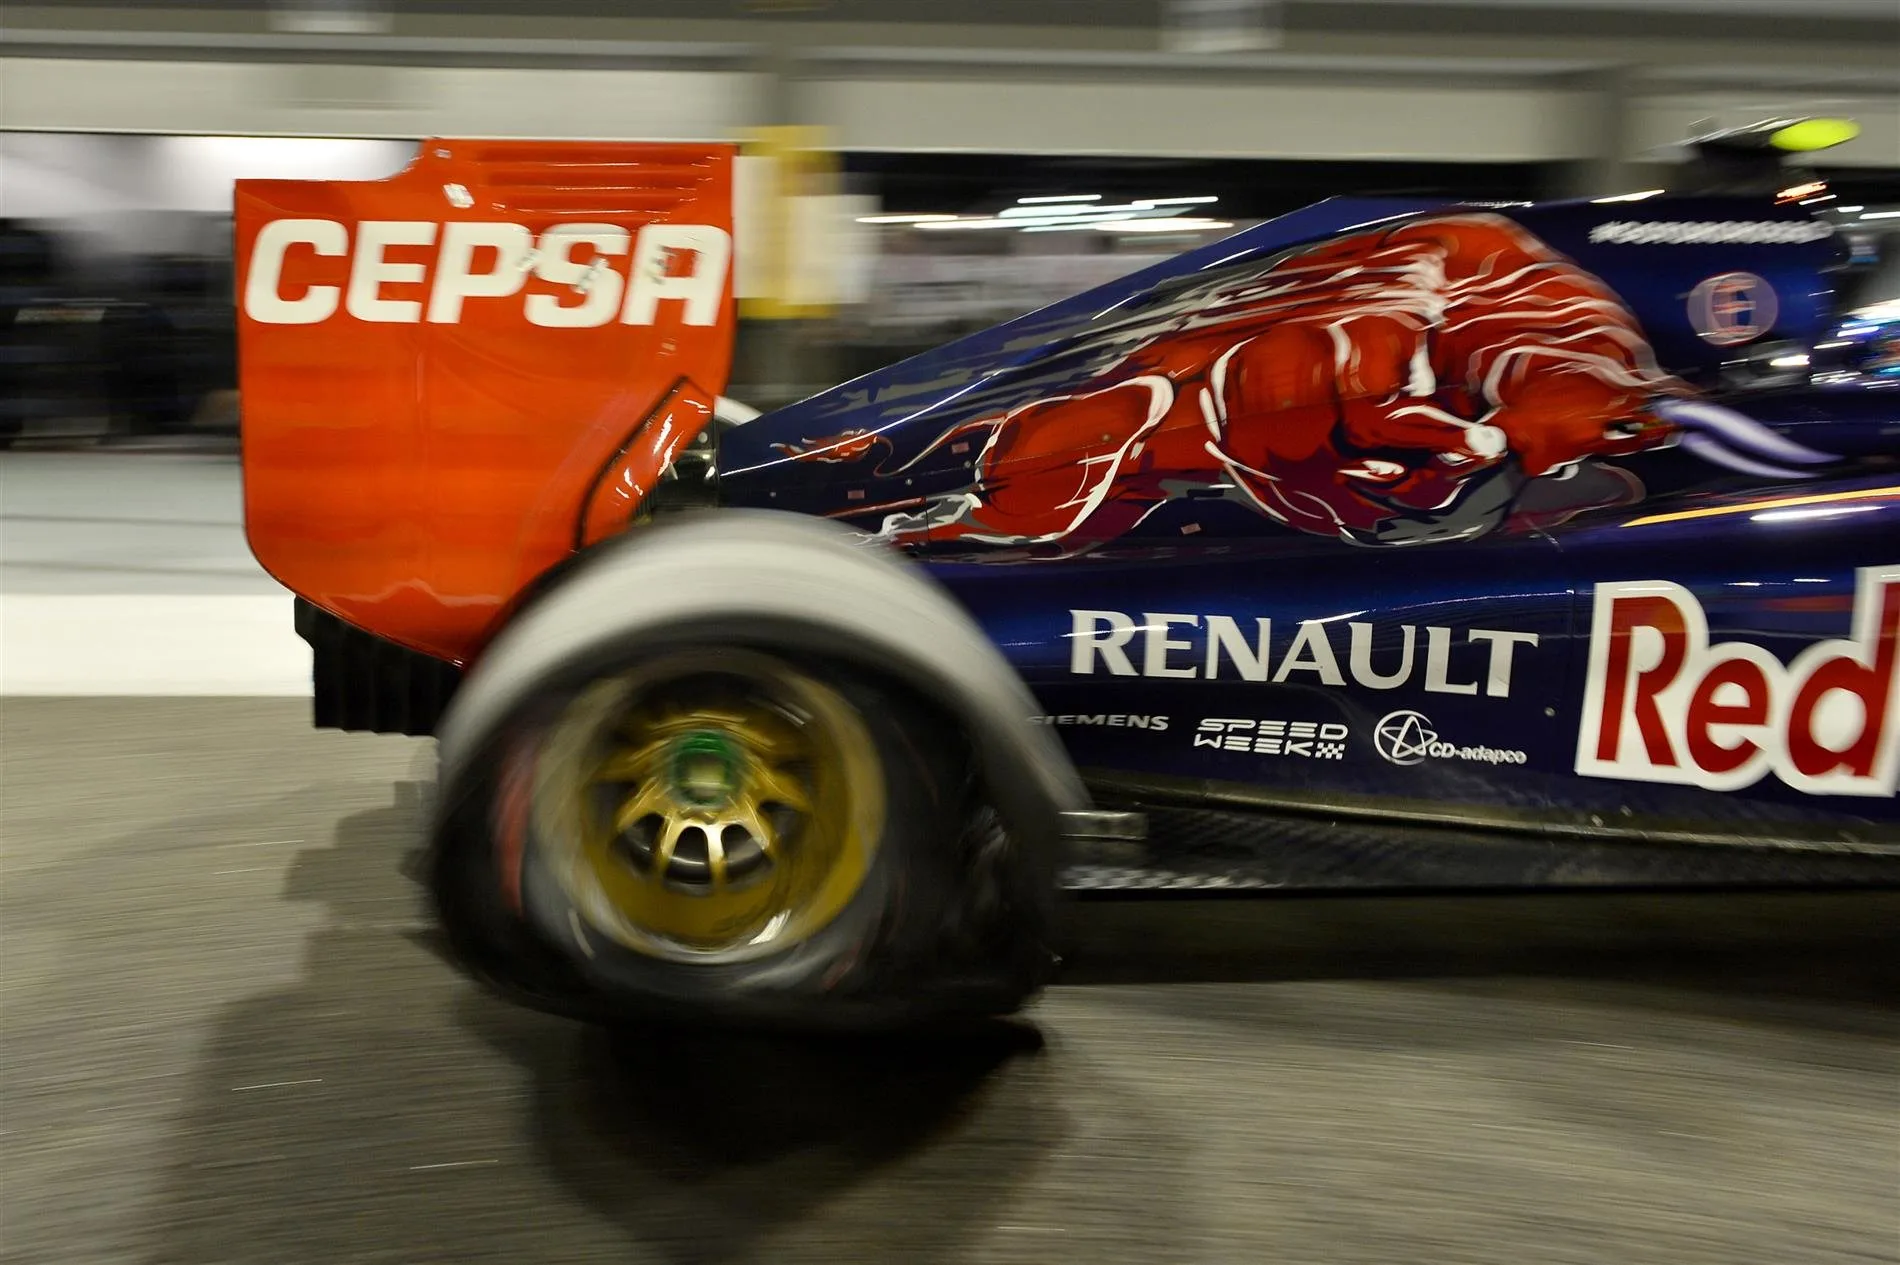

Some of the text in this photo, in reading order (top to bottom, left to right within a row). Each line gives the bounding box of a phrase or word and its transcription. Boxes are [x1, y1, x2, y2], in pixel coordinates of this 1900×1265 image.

[245, 219, 732, 327] CEPSA
[1069, 609, 1538, 699] RENAULT
[1582, 570, 1900, 790] Red
[1027, 714, 1169, 731] SIEMENS
[1197, 718, 1348, 740] SPEED
[1193, 733, 1314, 757] WEEK
[1429, 741, 1527, 765] CD-adapco
